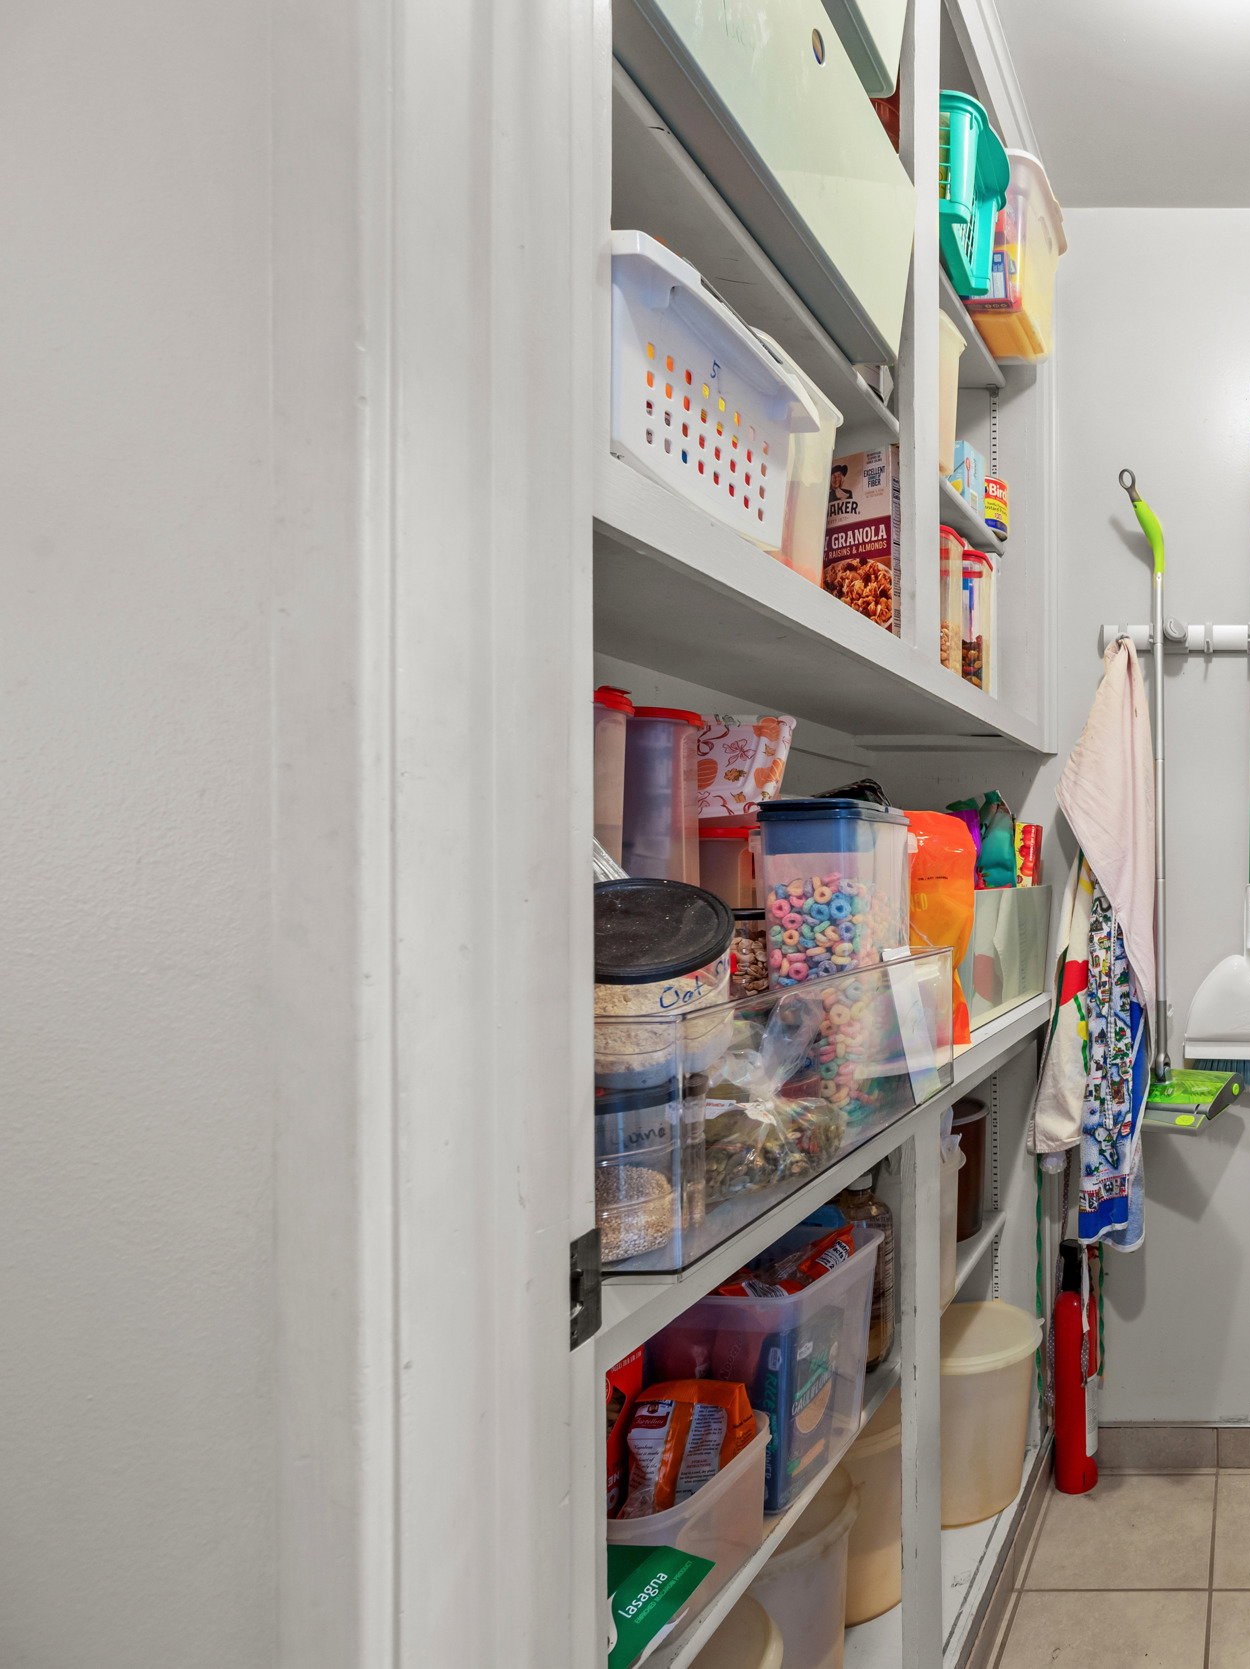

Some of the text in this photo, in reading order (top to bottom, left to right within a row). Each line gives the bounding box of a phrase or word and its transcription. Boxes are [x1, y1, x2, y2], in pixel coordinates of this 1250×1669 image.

[863, 465, 886, 478] EXCELLENT
[867, 478, 882, 489] FIBER
[827, 501, 859, 518] AKER
[831, 524, 887, 550] GRANOLA
[829, 540, 887, 560] RAISINS & ALMONDS
[659, 975, 705, 1009] Oat
[618, 1572, 669, 1619] lasagna
[634, 1560, 694, 1624] ENRICHED MACARONI PRODUCT
